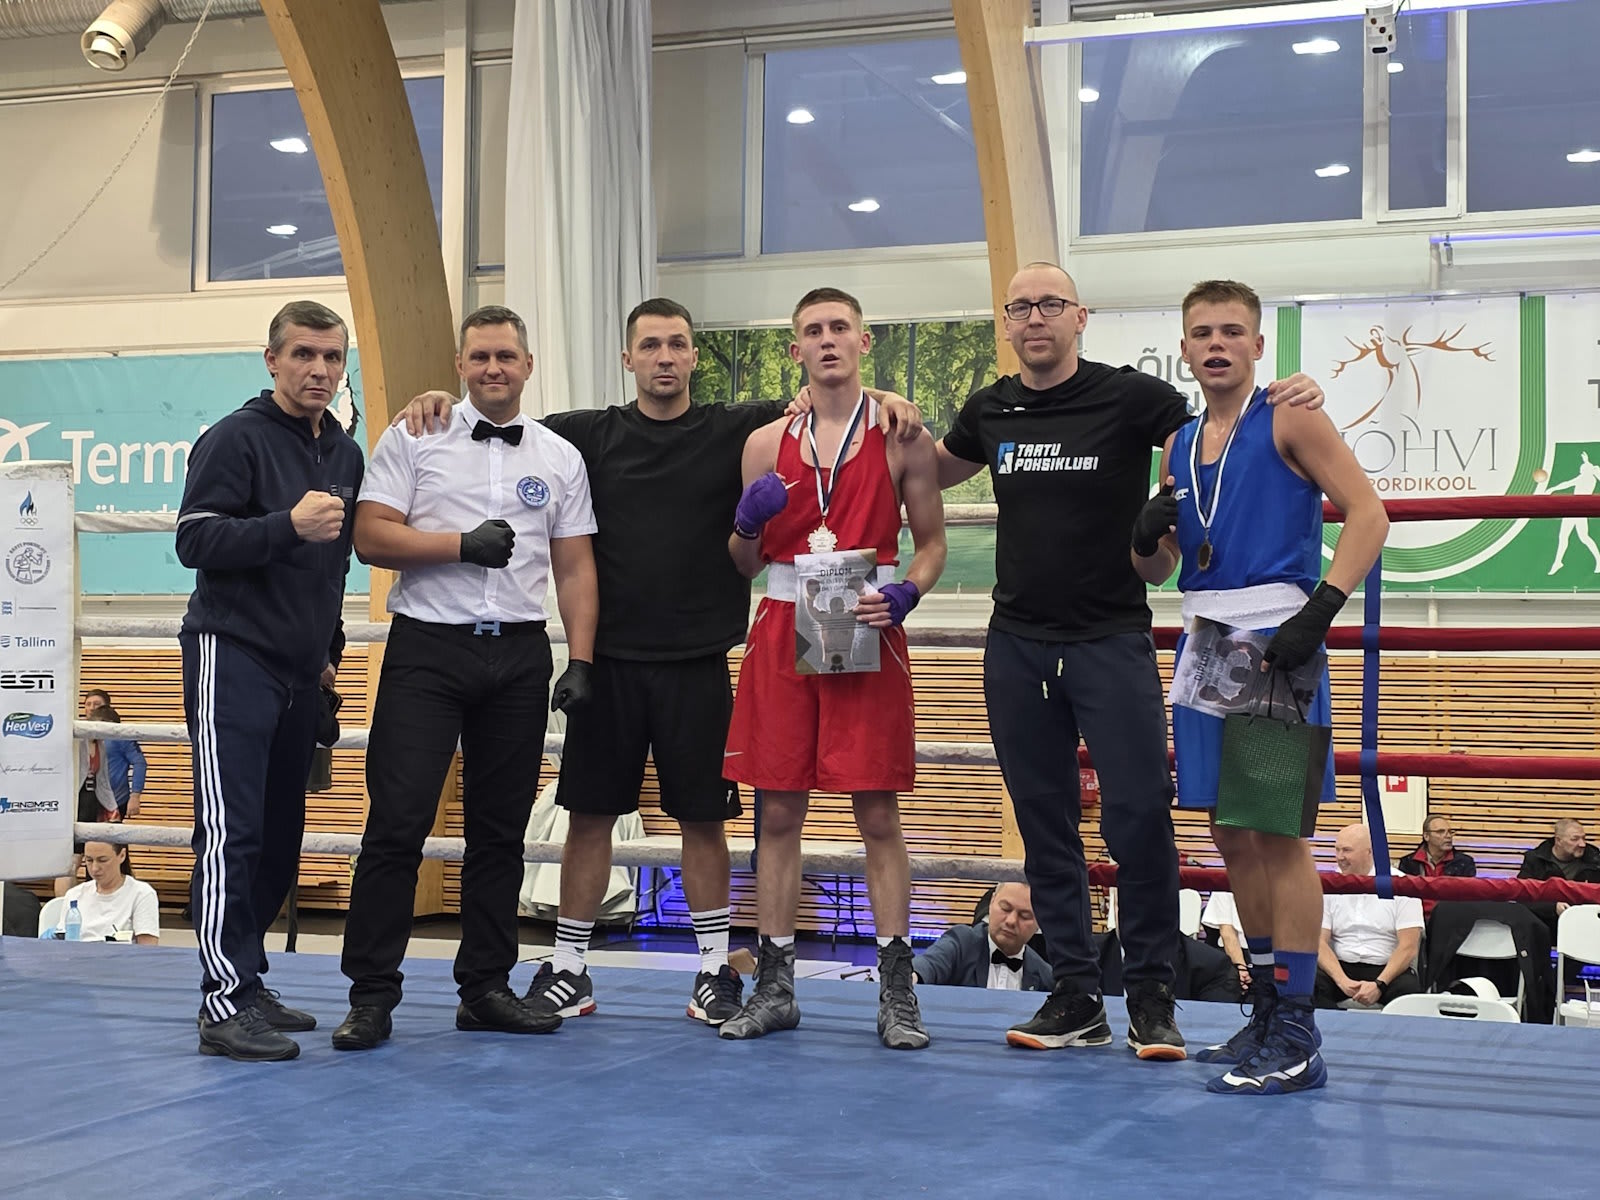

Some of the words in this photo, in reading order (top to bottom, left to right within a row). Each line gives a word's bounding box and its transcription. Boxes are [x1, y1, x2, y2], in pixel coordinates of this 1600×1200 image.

[1017, 443, 1062, 457] TARTU
[1340, 420, 1498, 474] ÕHVI
[62, 425, 210, 485] Term
[1014, 456, 1099, 472] POKSIKLUBI
[15, 636, 56, 648] Tallinn
[5, 721, 27, 732] Hea
[27, 720, 50, 732] Vesi
